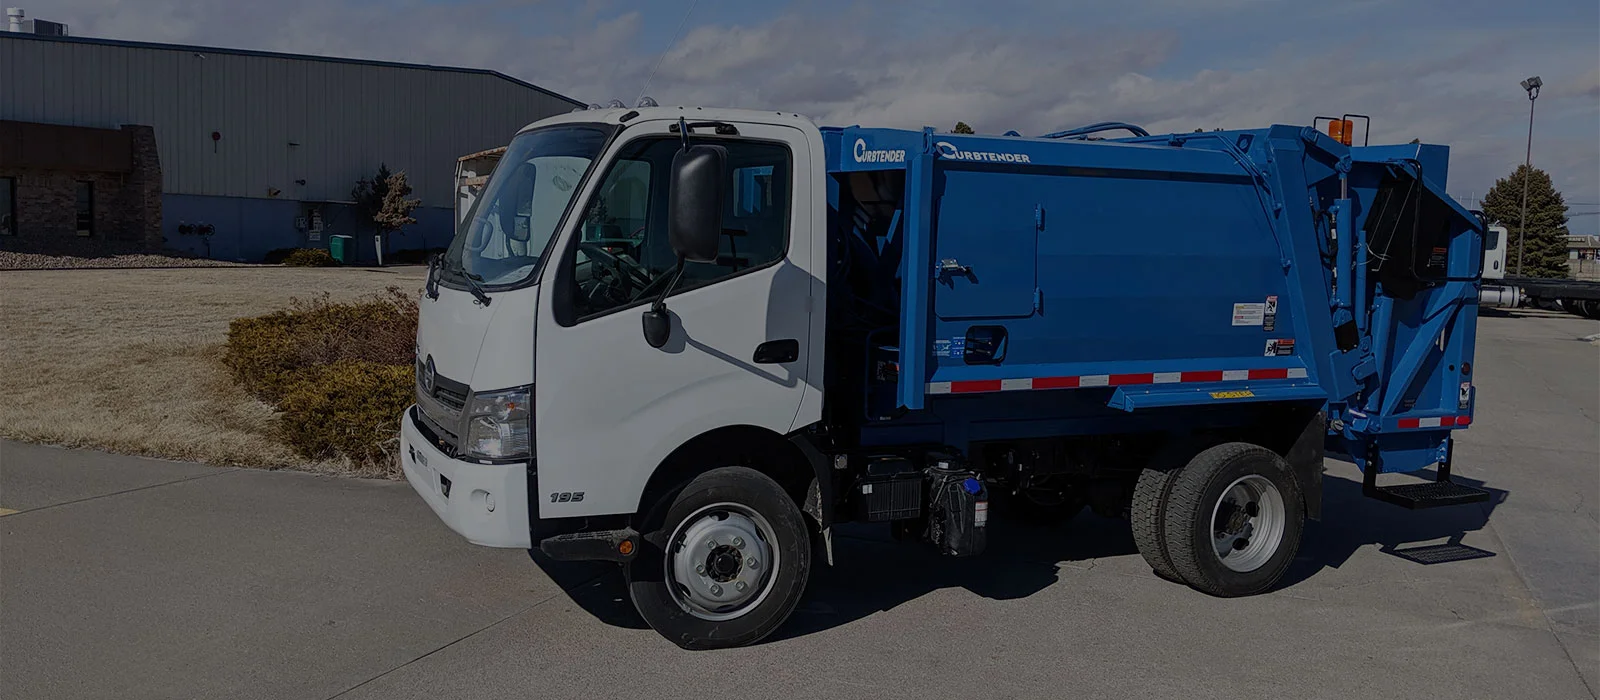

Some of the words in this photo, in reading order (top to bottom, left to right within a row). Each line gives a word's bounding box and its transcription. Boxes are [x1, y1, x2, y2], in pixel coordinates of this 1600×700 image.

[854, 138, 905, 163] CURBTENDER
[936, 141, 1031, 163] CURBTENDER
[550, 492, 584, 502] 195
